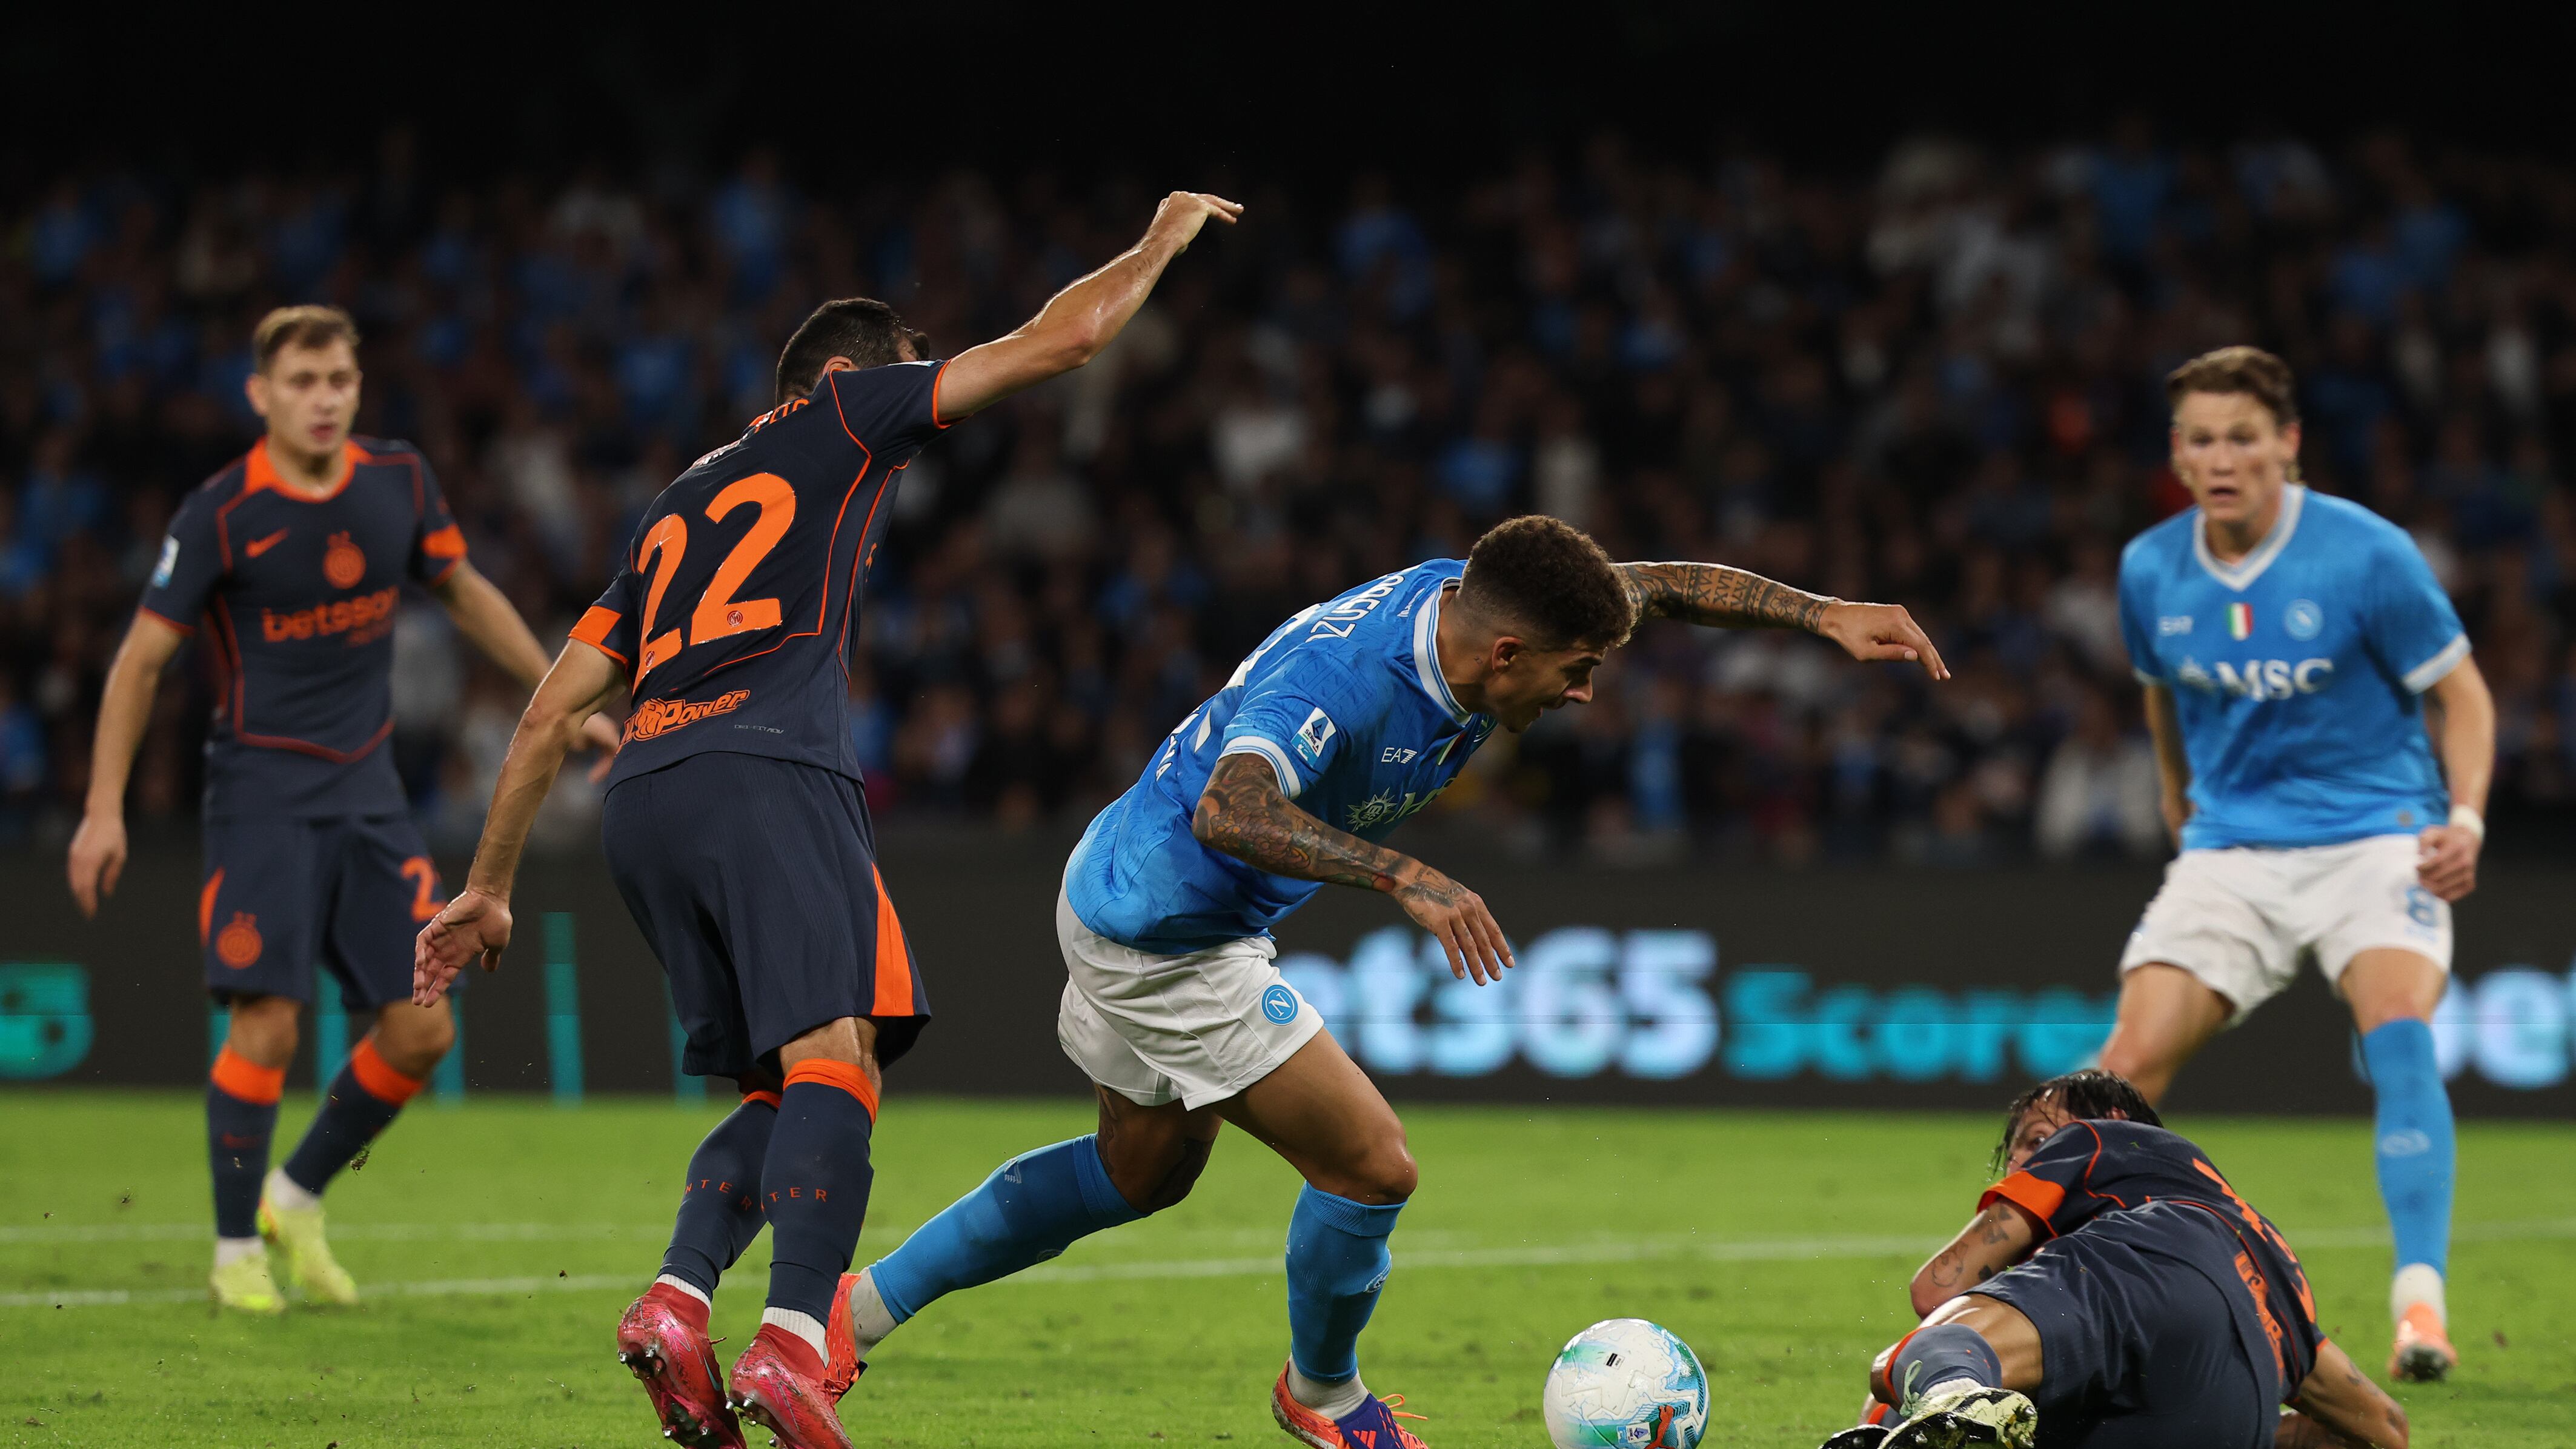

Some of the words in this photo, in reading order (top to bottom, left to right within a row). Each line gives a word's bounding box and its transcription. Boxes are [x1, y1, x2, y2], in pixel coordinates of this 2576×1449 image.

[632, 471, 796, 696] 22
[1304, 565, 1421, 644] ORENZ
[2215, 658, 2333, 703] MSC
[1304, 728, 1317, 745] SERIE
[1381, 747, 1418, 764] EA7
[2406, 885, 2437, 927] 8
[1269, 993, 1291, 1017] N
[1275, 922, 1721, 1081] t365
[1722, 964, 2120, 1084] Score
[685, 1179, 752, 1211] NTER
[760, 1187, 827, 1212] TER
